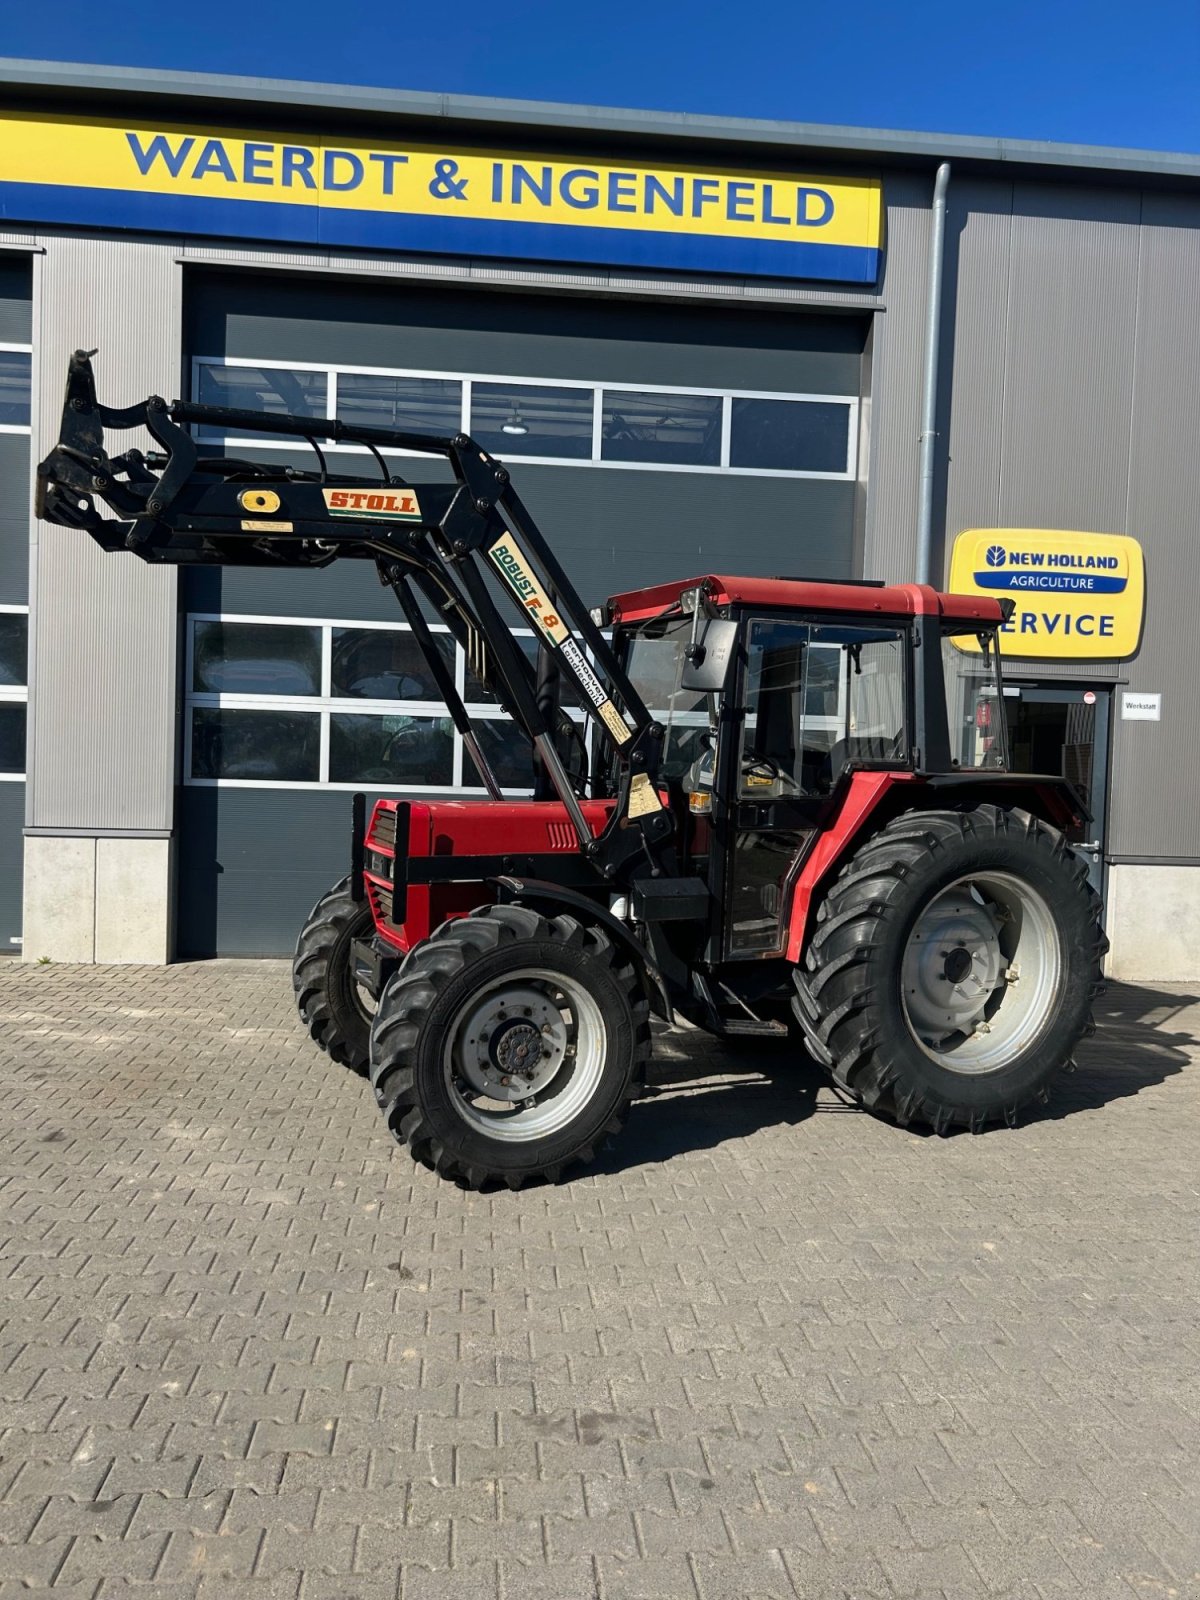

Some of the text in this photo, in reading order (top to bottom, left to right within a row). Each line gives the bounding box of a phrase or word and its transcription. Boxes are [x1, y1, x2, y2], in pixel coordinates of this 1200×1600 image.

[125, 133, 835, 228] WAERDT & INGENFELD
[329, 491, 416, 513] STOLL
[1009, 552, 1119, 570] NEW HOLLAND
[494, 544, 538, 598] ROBUST
[524, 597, 543, 609] F
[542, 614, 559, 628] 8
[1009, 575, 1094, 590] AGRICULTURE
[1000, 611, 1115, 637] ERVICE
[561, 644, 601, 705] Landtechnik
[567, 640, 606, 701] terhoeven
[1125, 702, 1157, 710] Werkstatt
